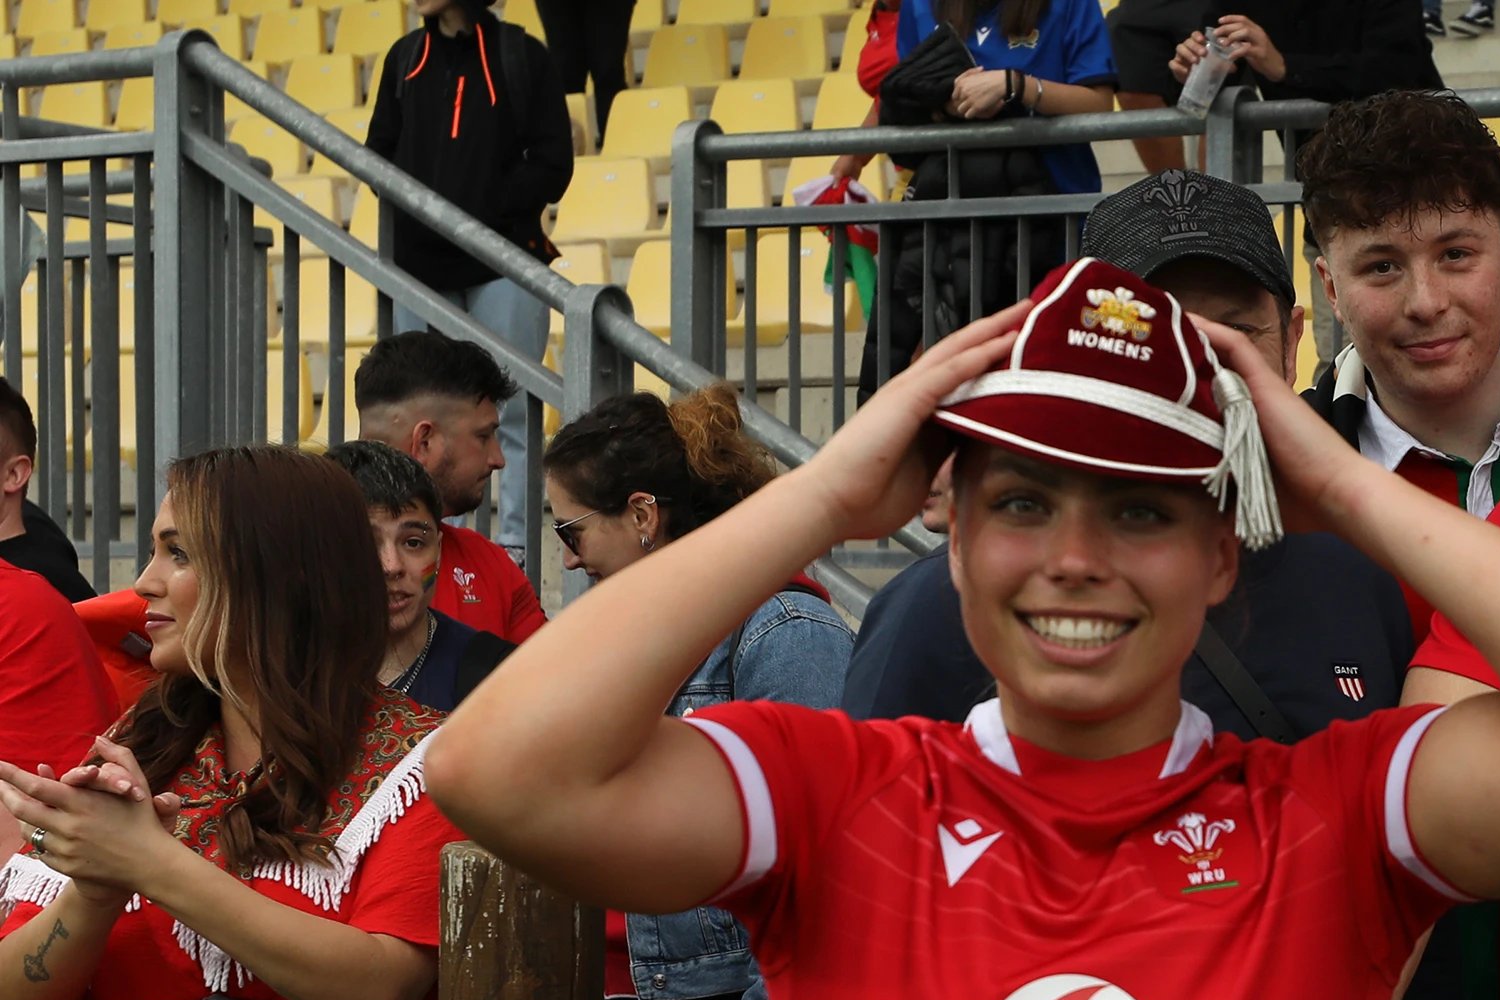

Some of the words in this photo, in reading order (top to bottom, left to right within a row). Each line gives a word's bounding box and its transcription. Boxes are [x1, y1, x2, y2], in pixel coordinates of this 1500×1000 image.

[1167, 221, 1198, 234] WRU
[1067, 328, 1154, 362] WOMENS
[1333, 665, 1359, 675] GANT
[1187, 867, 1226, 885] WRU
